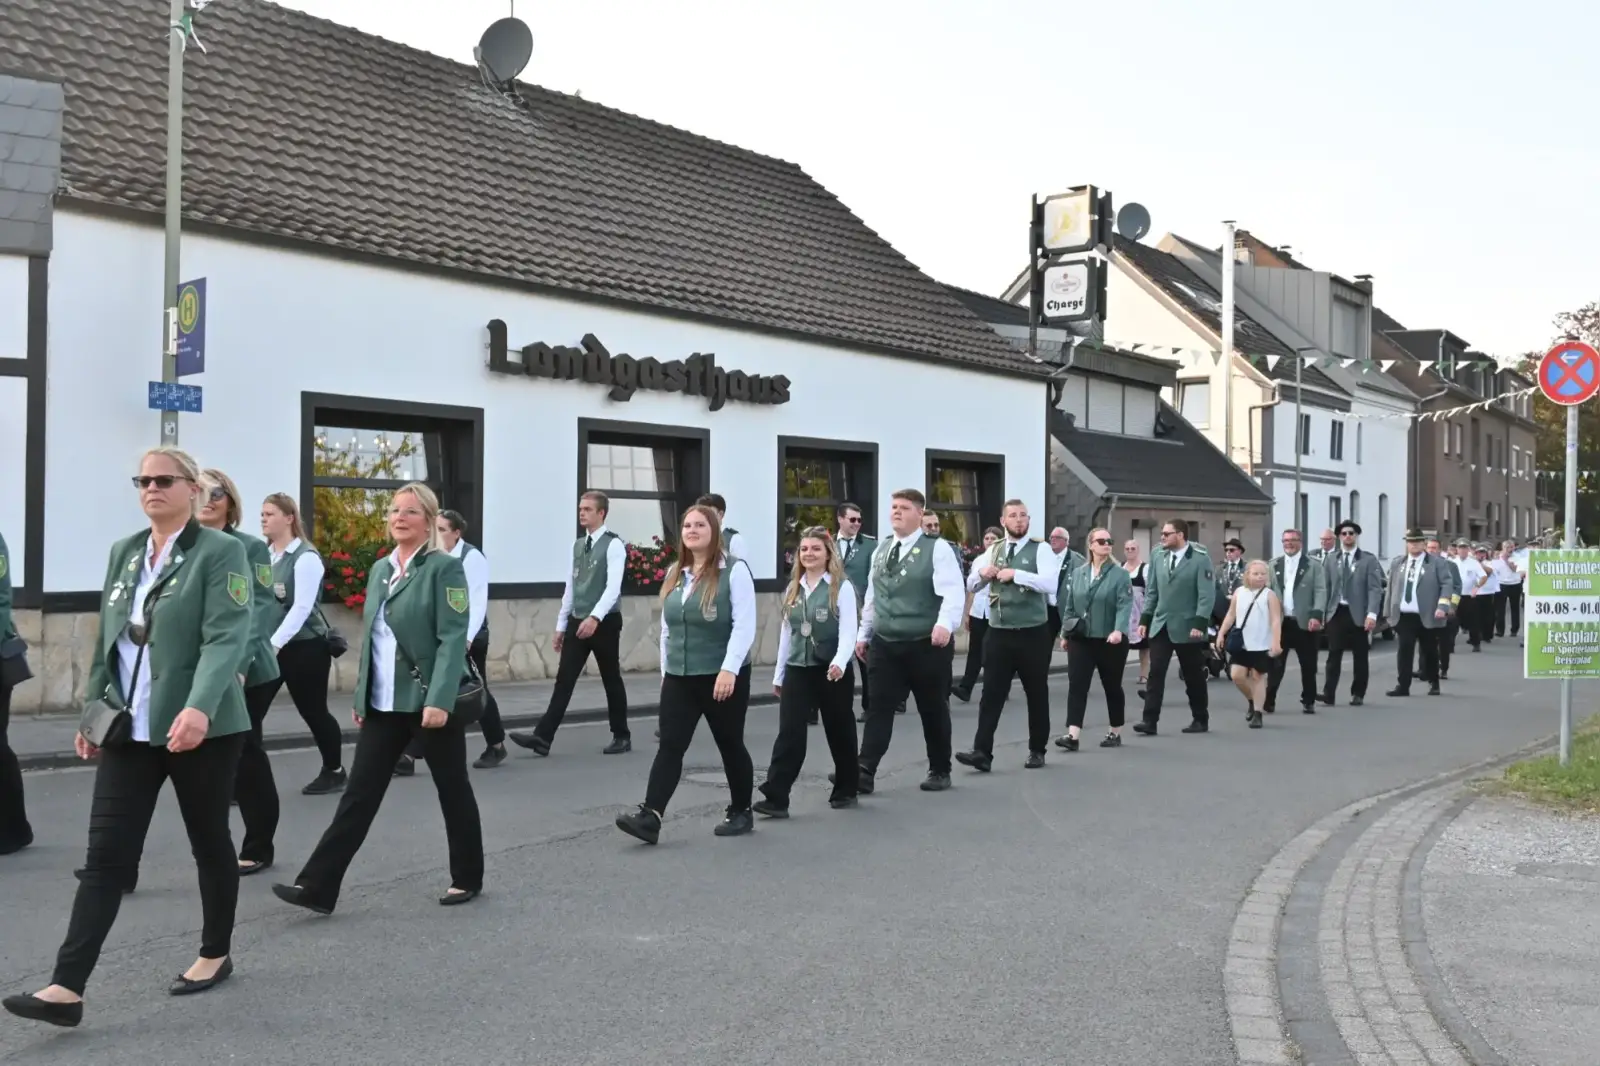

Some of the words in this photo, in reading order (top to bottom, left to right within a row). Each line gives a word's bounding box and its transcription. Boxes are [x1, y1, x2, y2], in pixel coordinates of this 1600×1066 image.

[183, 297, 193, 322] H
[1046, 296, 1083, 311] Chargé
[486, 318, 791, 411] Landgasthaus
[1552, 578, 1563, 590] in
[1565, 578, 1592, 590] Rahm
[1535, 601, 1569, 615] 30.08
[1547, 629, 1599, 645] Festplatz
[1541, 645, 1555, 653] am
